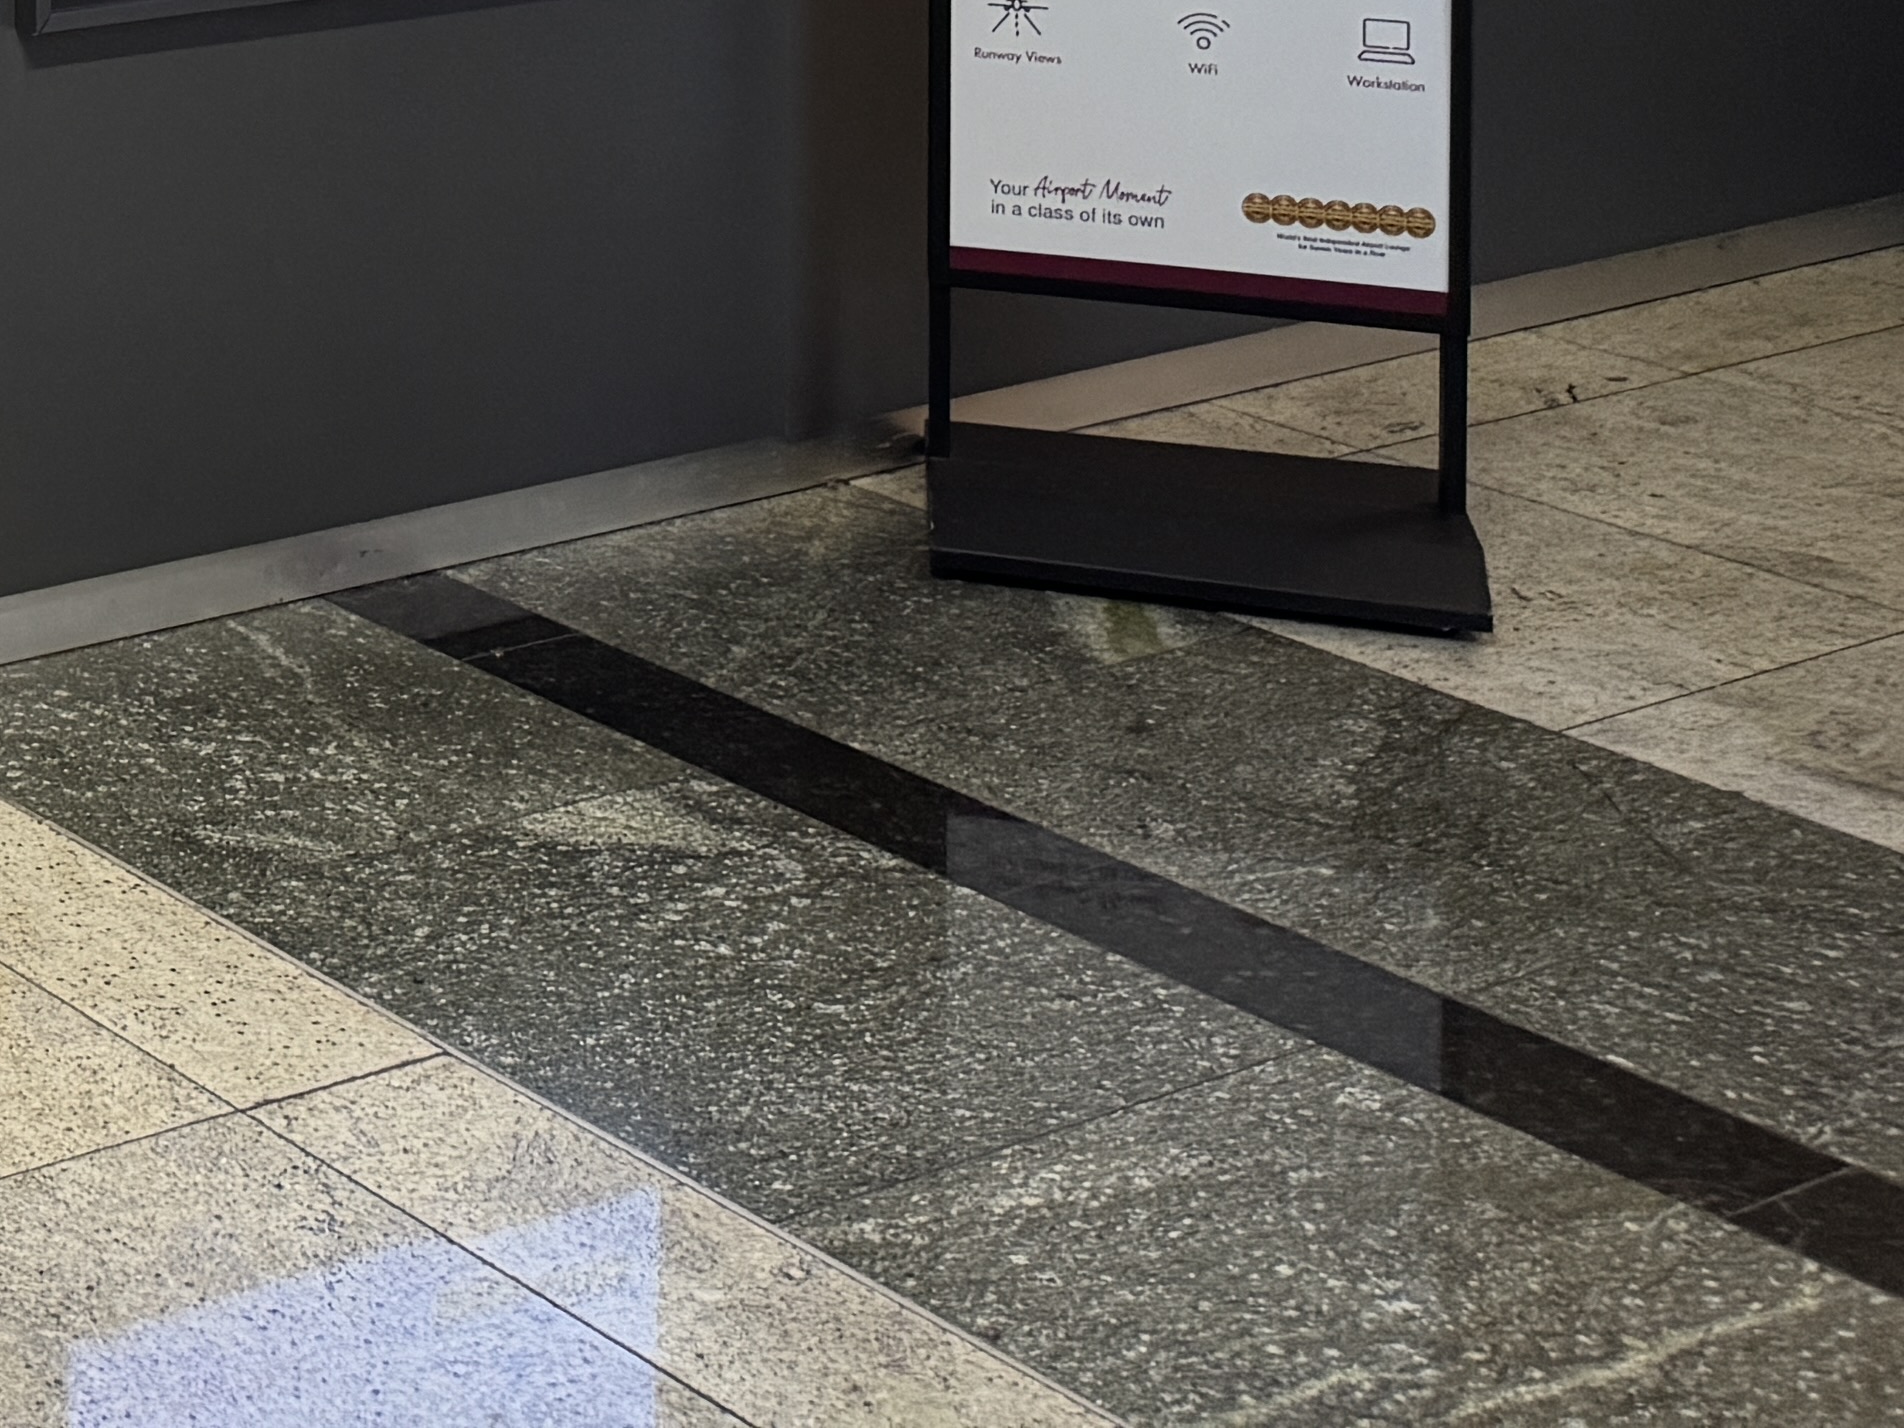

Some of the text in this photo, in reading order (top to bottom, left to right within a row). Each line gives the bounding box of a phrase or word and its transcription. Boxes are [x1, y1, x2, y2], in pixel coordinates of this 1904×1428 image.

[973, 46, 1063, 65] Runway Views
[1346, 74, 1426, 93] Workstation
[989, 174, 1173, 207] Your Airport Moment
[990, 198, 1165, 229] in a class of its own
